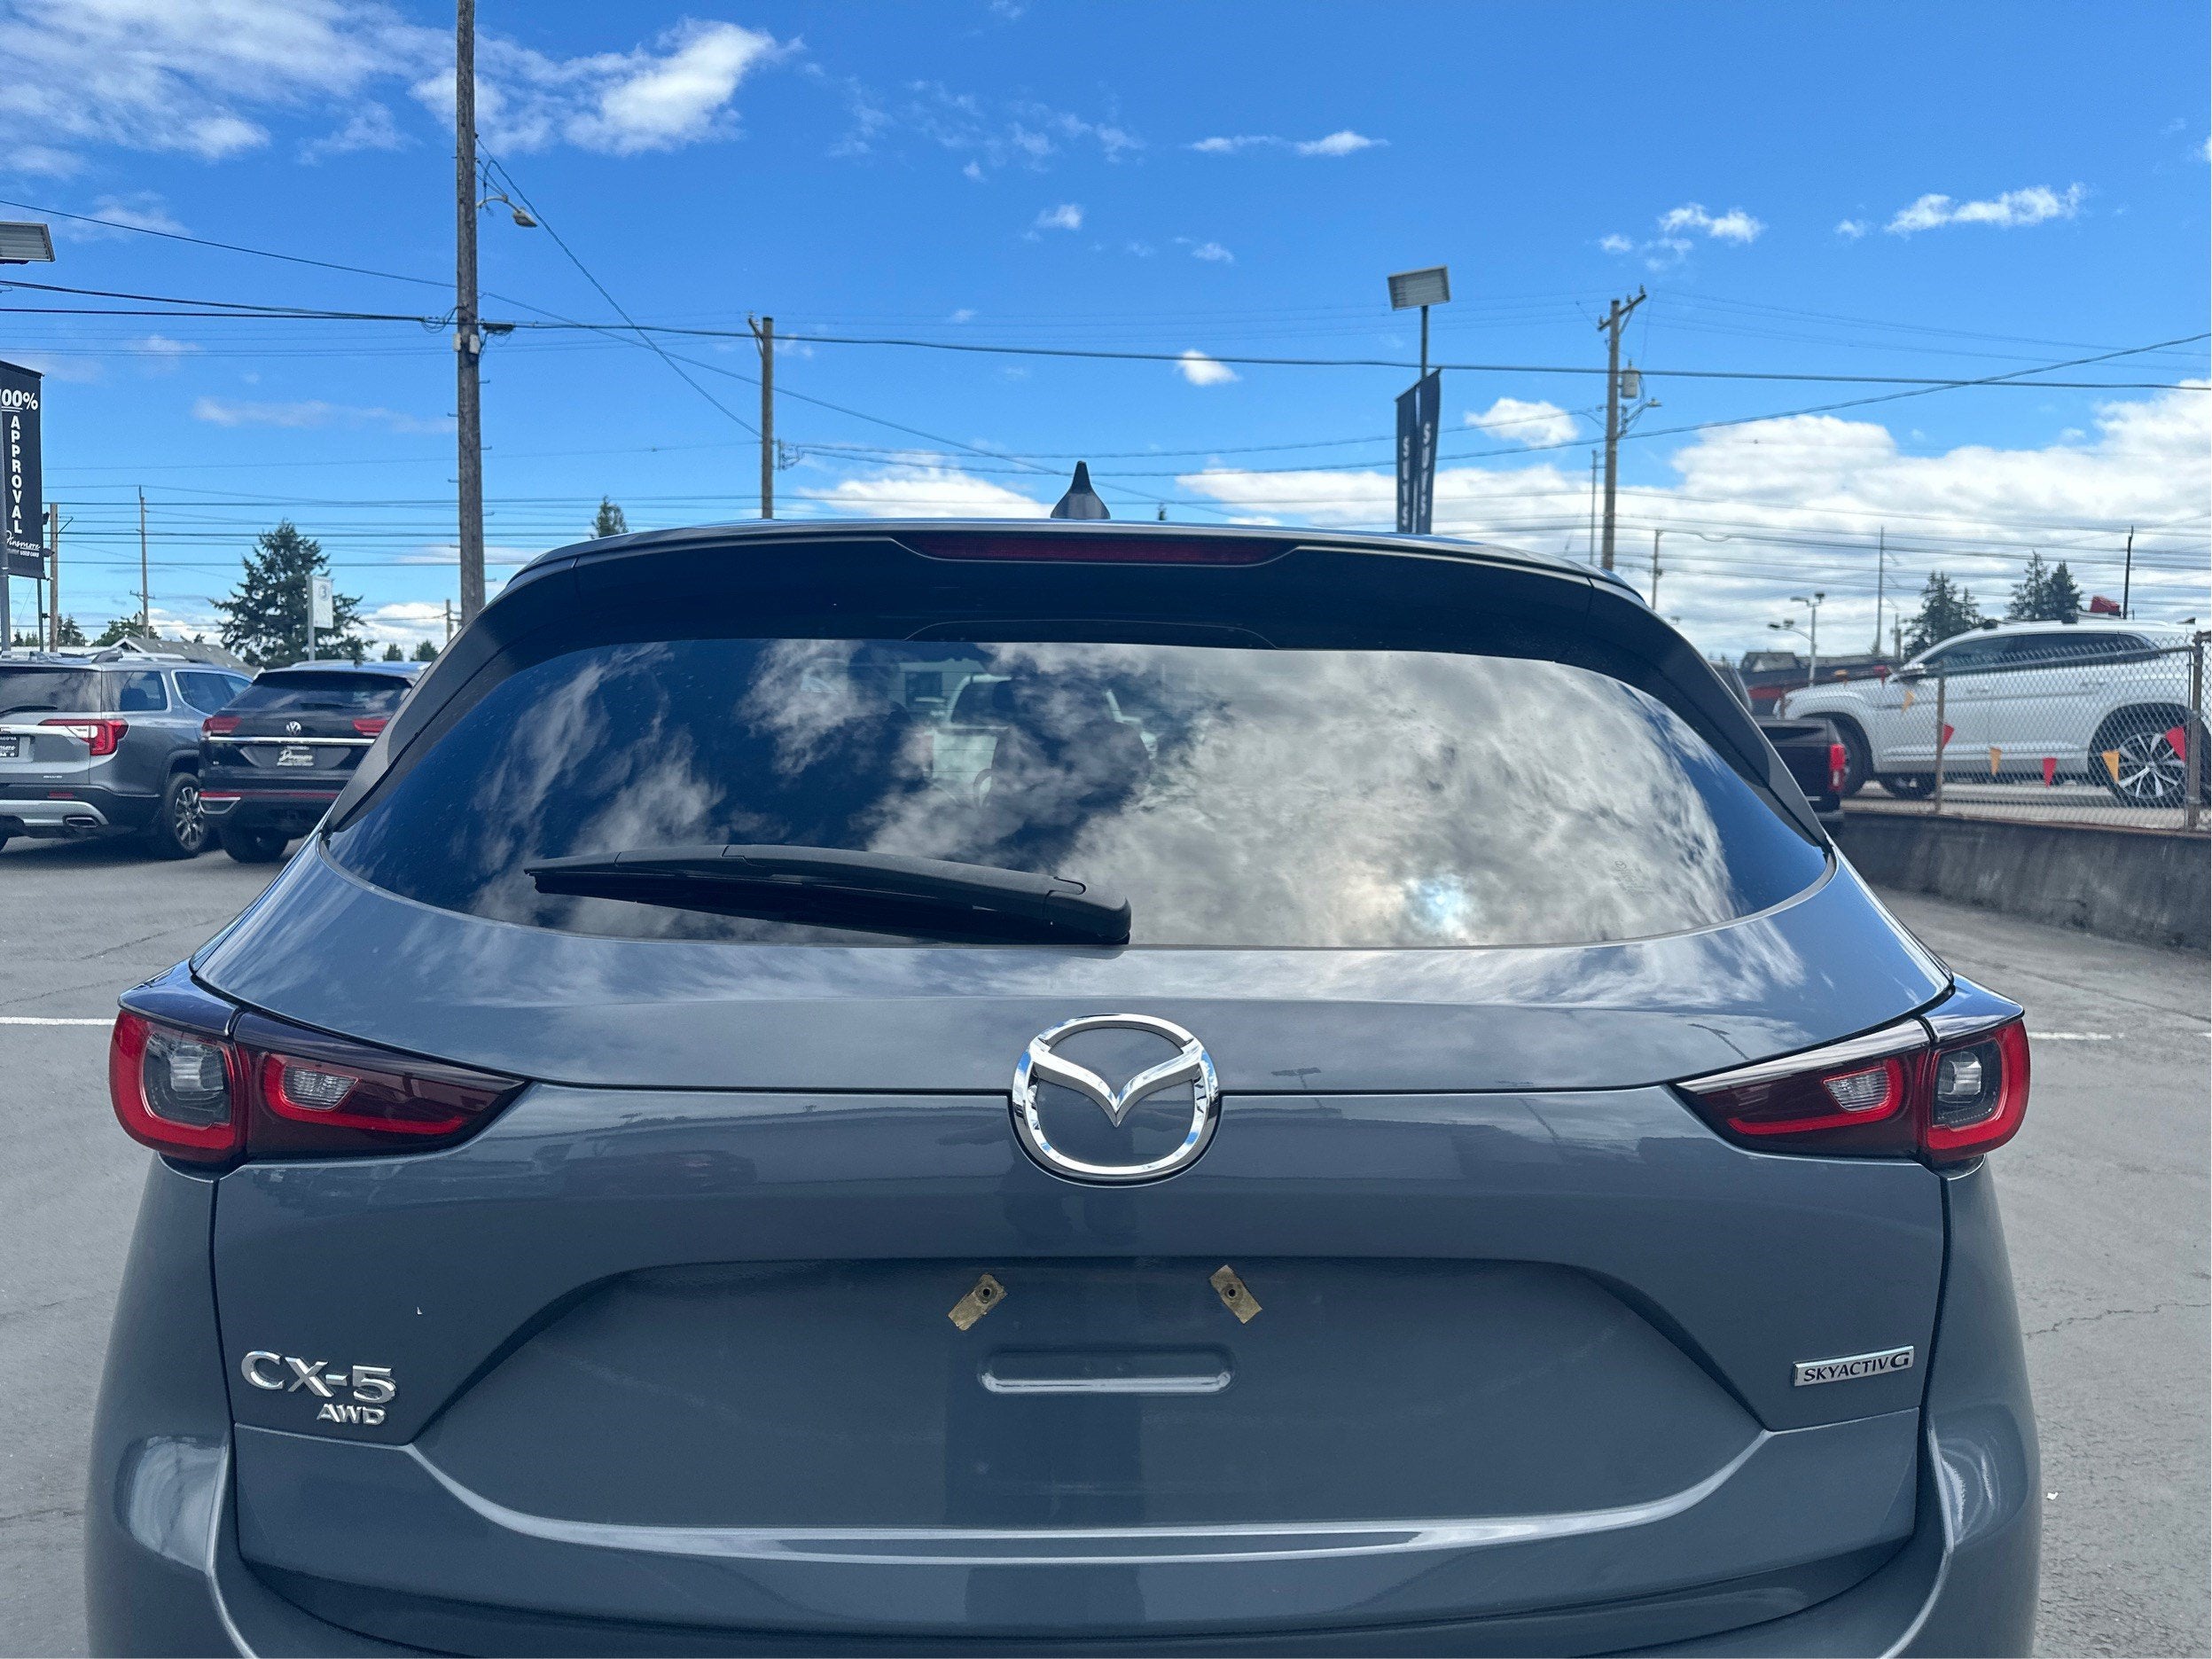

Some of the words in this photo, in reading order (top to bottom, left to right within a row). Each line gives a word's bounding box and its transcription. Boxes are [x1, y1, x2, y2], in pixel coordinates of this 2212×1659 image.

[0, 388, 38, 411] 00%
[11, 415, 23, 534] APPROVAL
[241, 1350, 396, 1404] CX-5
[317, 1403, 387, 1426] AWD
